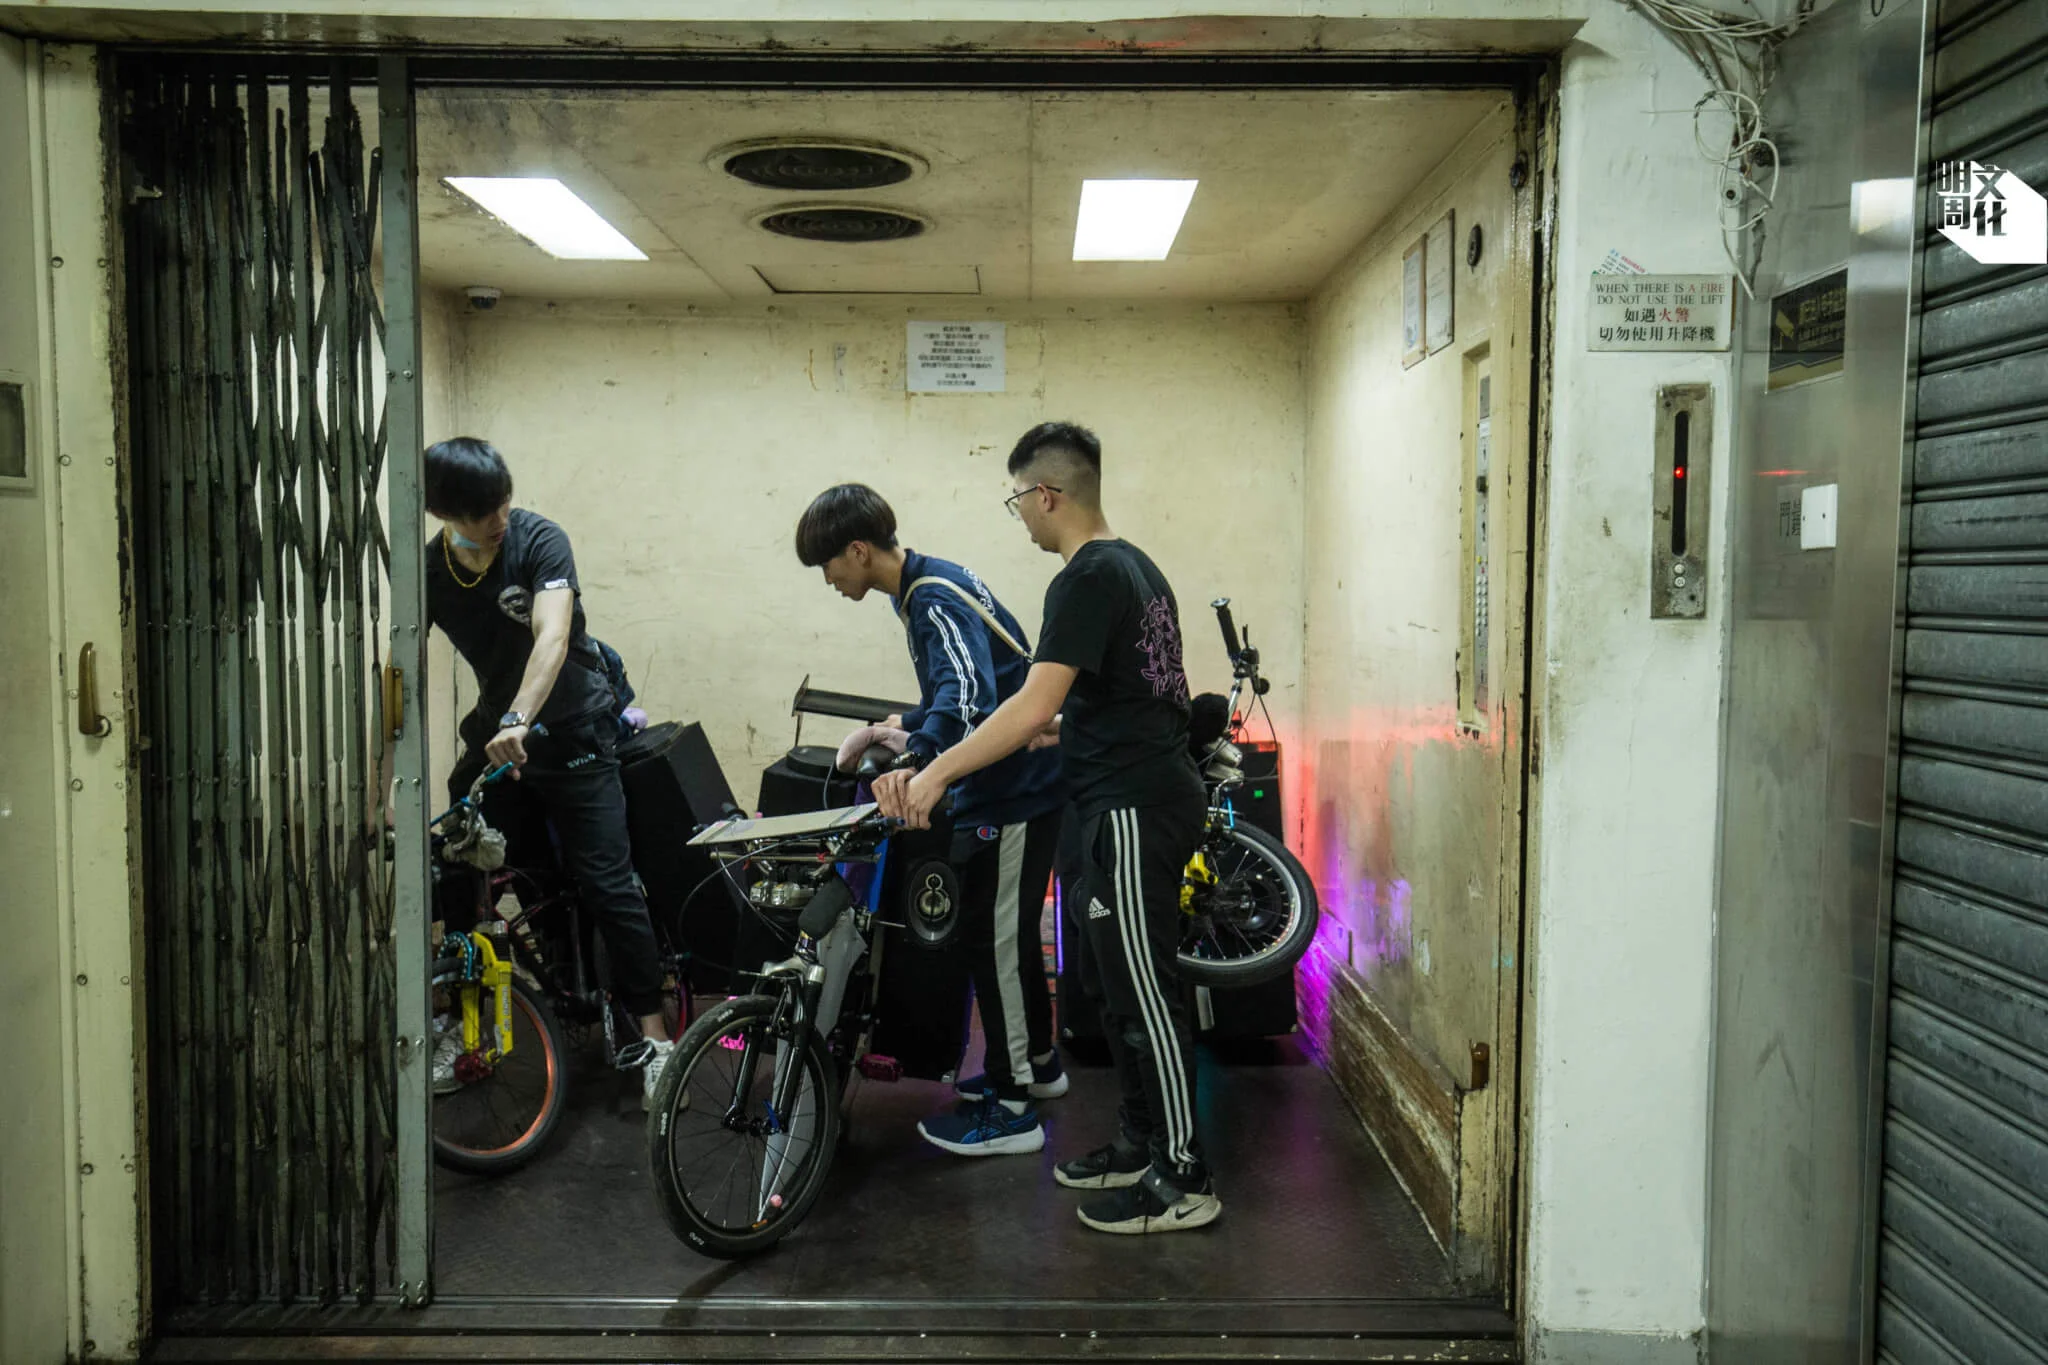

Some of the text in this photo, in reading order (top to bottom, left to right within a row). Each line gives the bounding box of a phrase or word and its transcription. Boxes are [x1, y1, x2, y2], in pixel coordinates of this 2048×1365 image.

[1595, 283, 1726, 294] WHEN THERE IS A FIRE
[1597, 294, 1726, 305] DO NOT USE THE LIFT
[1624, 307, 1690, 323] 如遇火警
[1599, 326, 1716, 342] 切勿使用升降機
